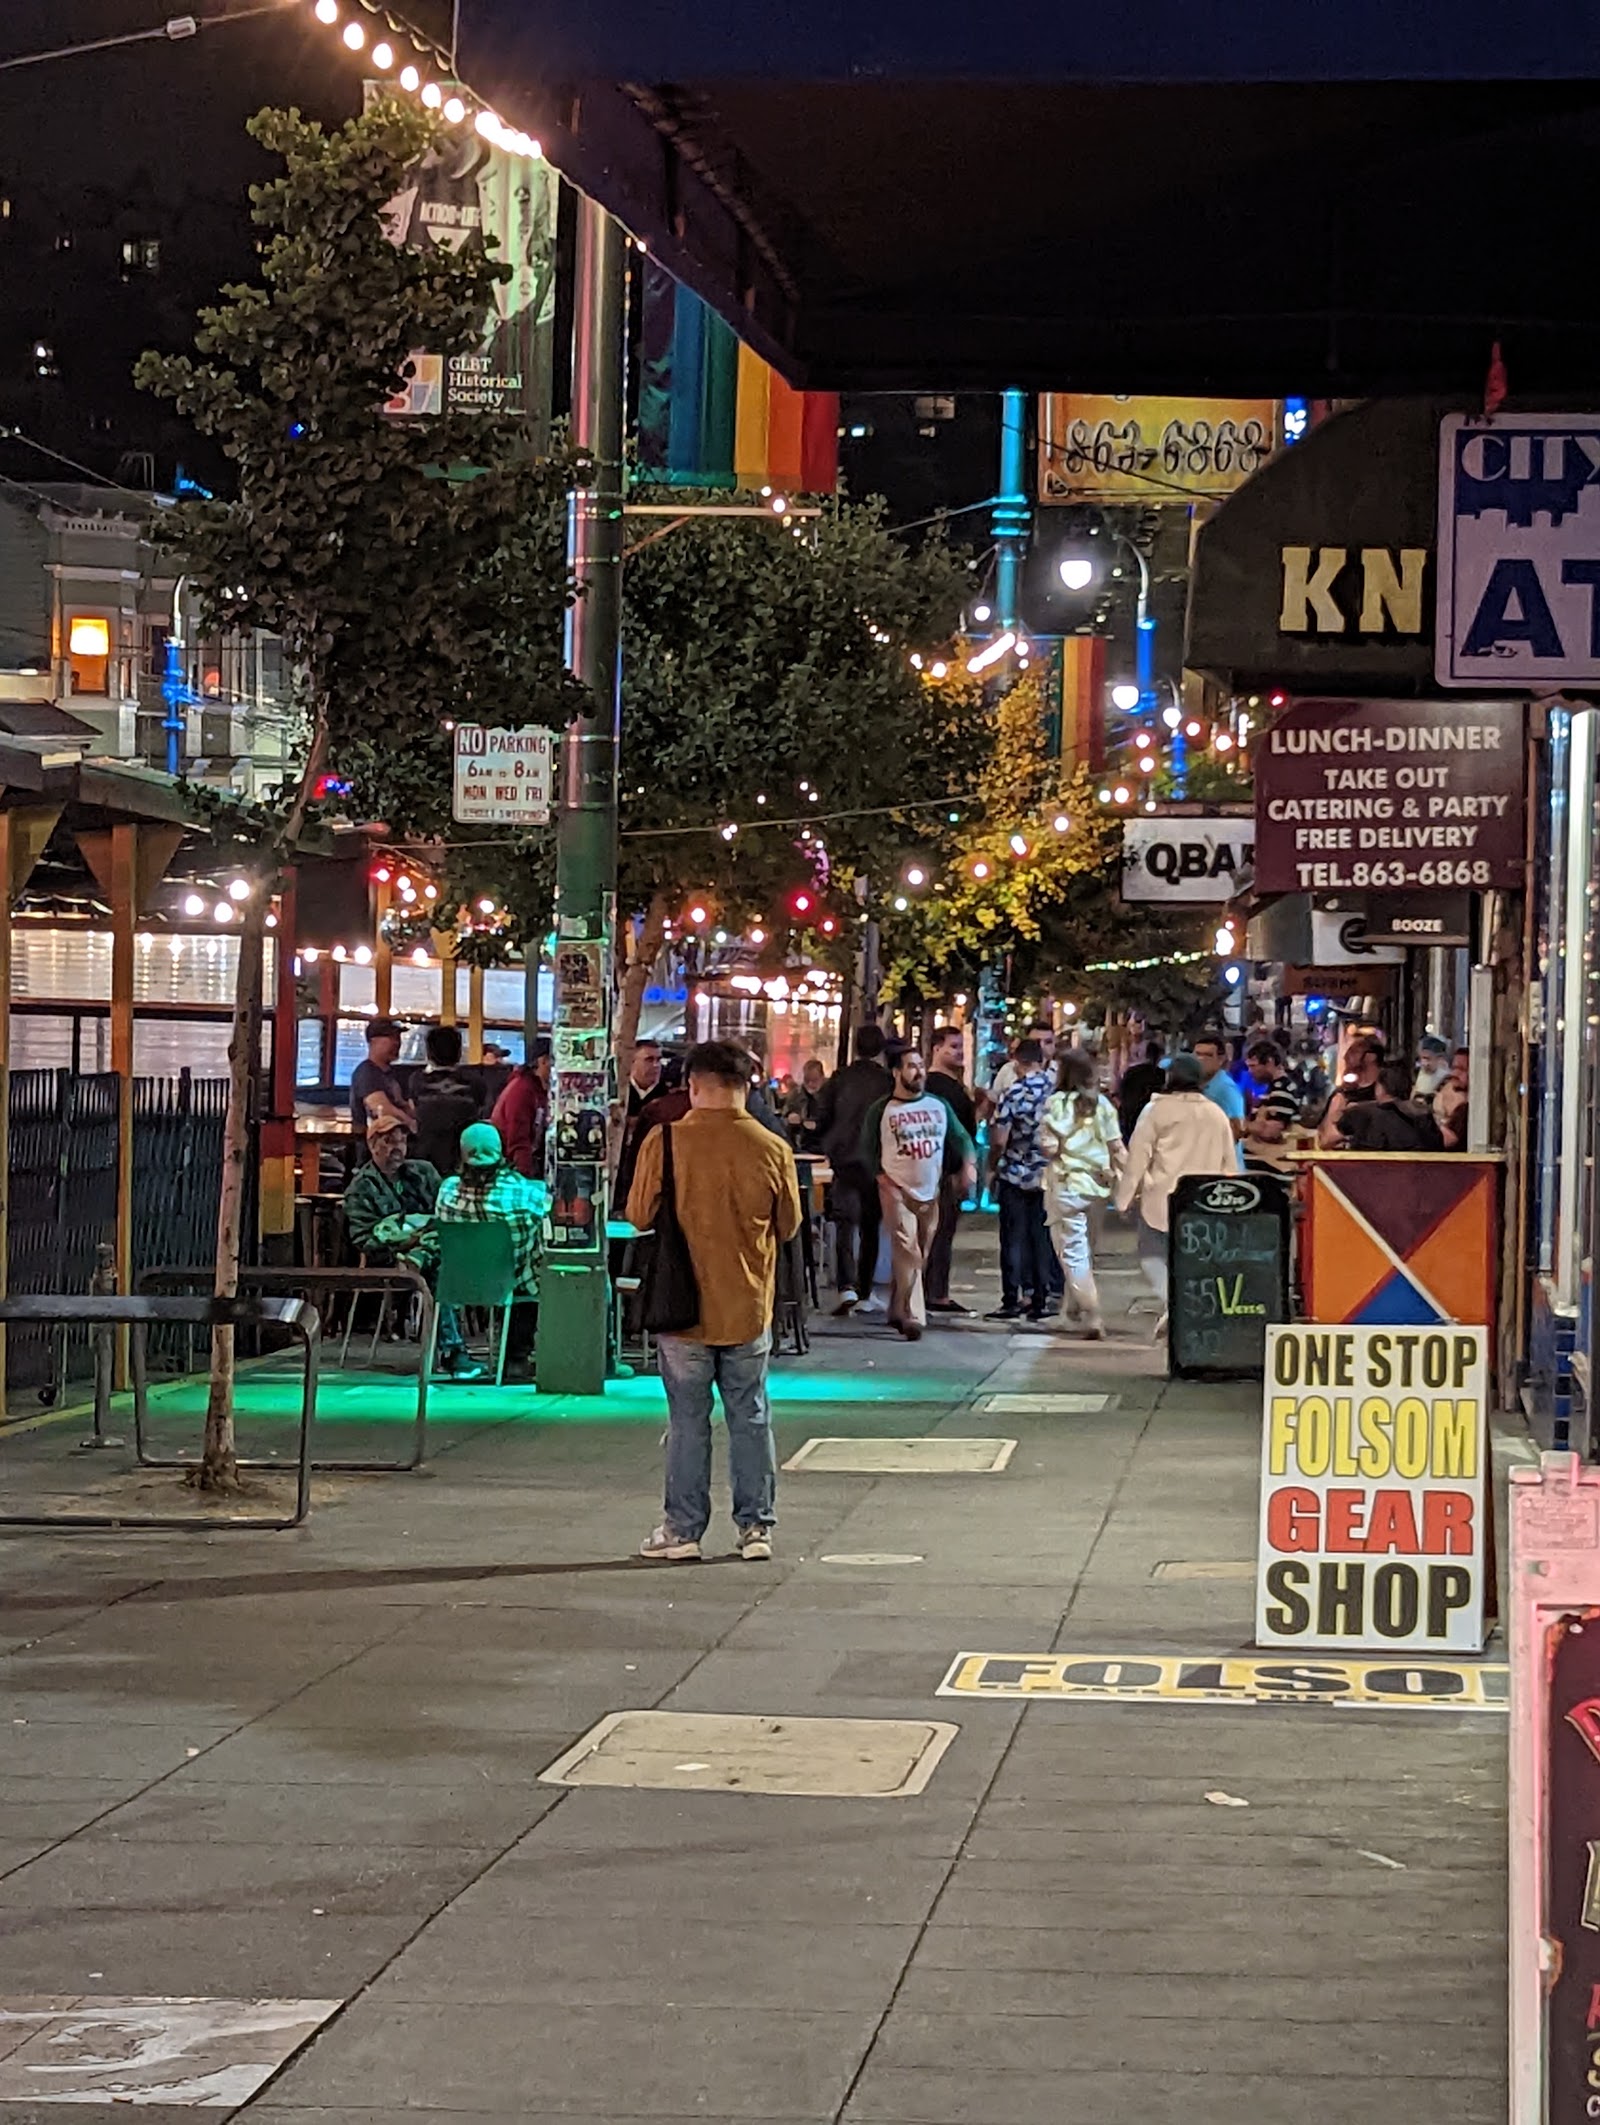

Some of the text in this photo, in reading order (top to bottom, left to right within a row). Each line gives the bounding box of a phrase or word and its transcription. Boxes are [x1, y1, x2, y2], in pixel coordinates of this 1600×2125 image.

[449, 356, 492, 372] GLBT
[449, 373, 523, 389] Historical
[448, 388, 504, 407] Society
[459, 728, 546, 754] NO PARKING
[1271, 726, 1501, 754] LUNCH-DINNER
[1324, 767, 1449, 790] TAKE OUT
[463, 784, 542, 801] MON WED FRI
[1267, 795, 1509, 821] CATERING & PARTY
[1295, 825, 1478, 850] FREE DELIVERY
[1296, 860, 1491, 887] TEL.863-6868
[1391, 919, 1442, 933] BOOZE
[909, 1140, 933, 1161] HO
[1273, 1333, 1354, 1386] ONE
[1366, 1334, 1477, 1388] STOP
[1269, 1396, 1478, 1479] FOLSOM
[1267, 1487, 1474, 1556] GEAR
[1265, 1560, 1471, 1637] SHOP
[977, 1659, 1509, 1698] FOLSO
